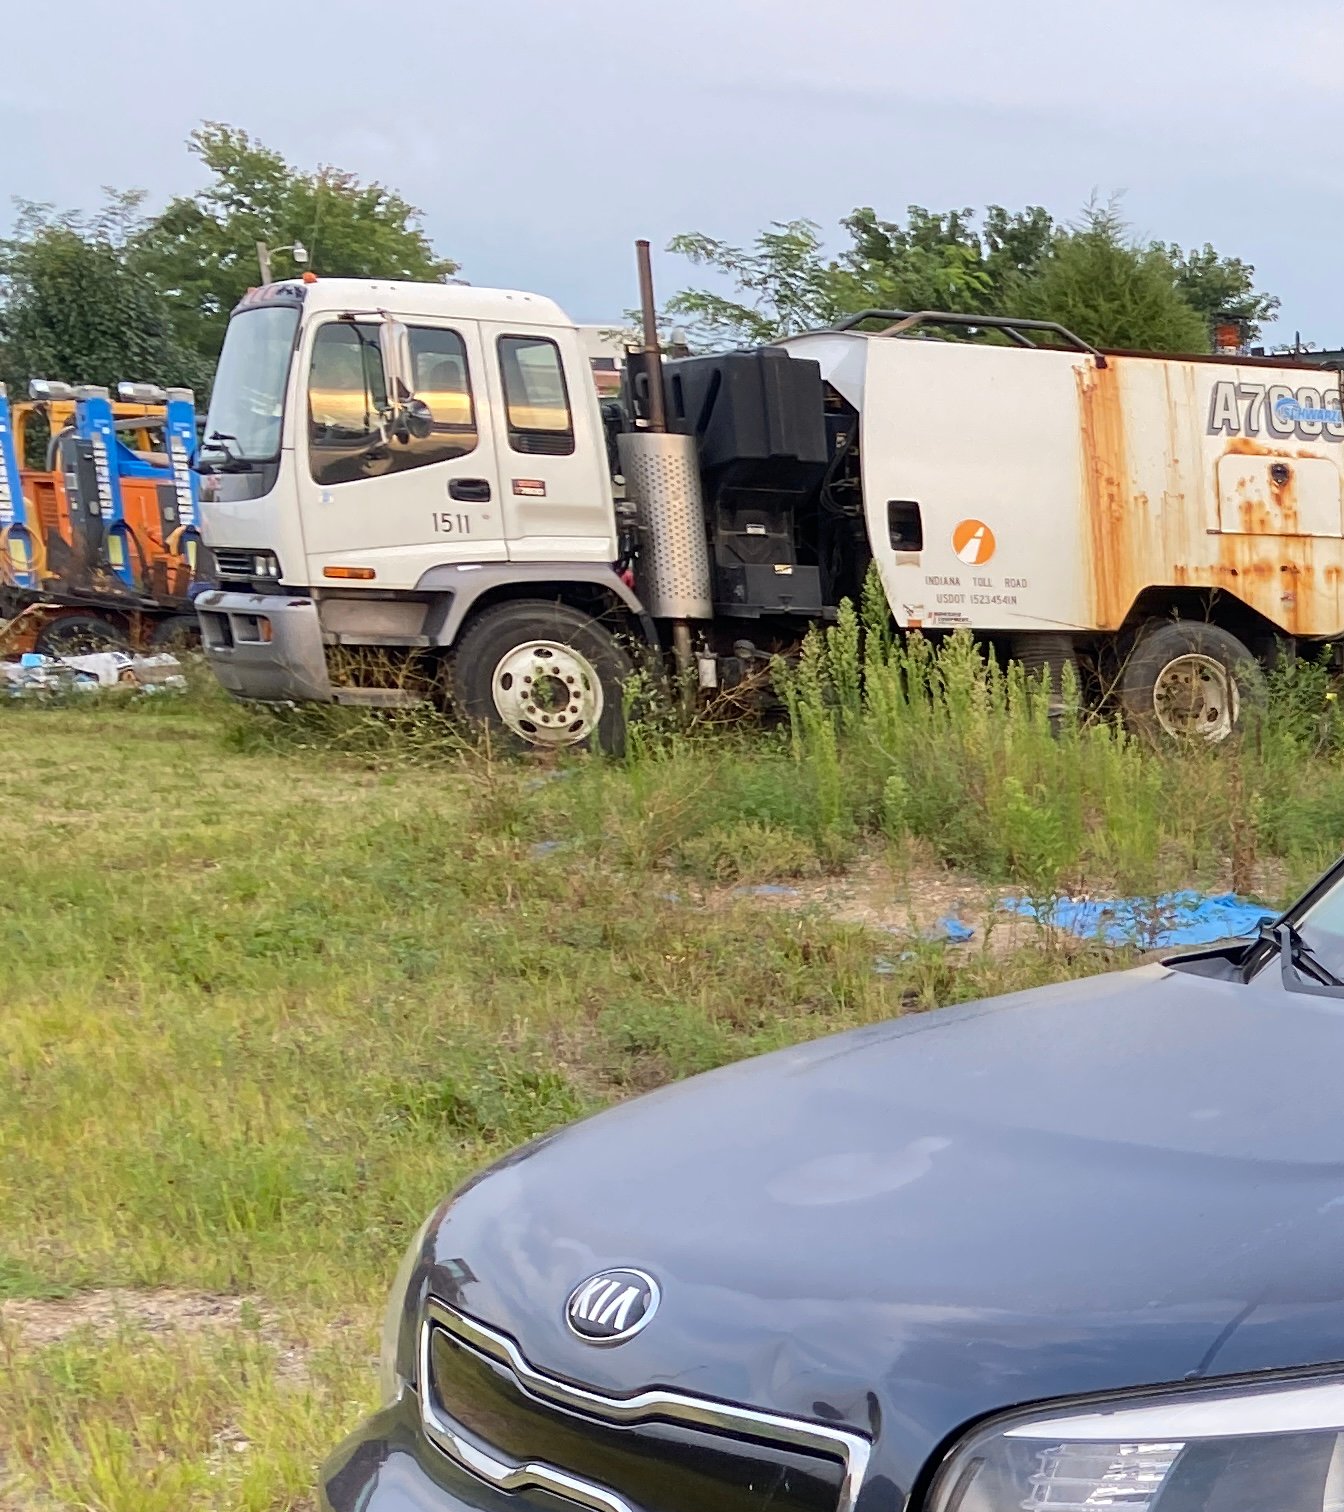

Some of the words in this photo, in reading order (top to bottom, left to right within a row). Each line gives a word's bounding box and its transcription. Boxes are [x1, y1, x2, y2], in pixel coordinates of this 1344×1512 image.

[432, 512, 471, 534] 1511
[925, 576, 960, 586] INDIANA
[973, 577, 992, 588] TOLL
[1004, 578, 1028, 588] ROAD
[936, 593, 965, 604] USDOT
[570, 1277, 640, 1331] KIA
